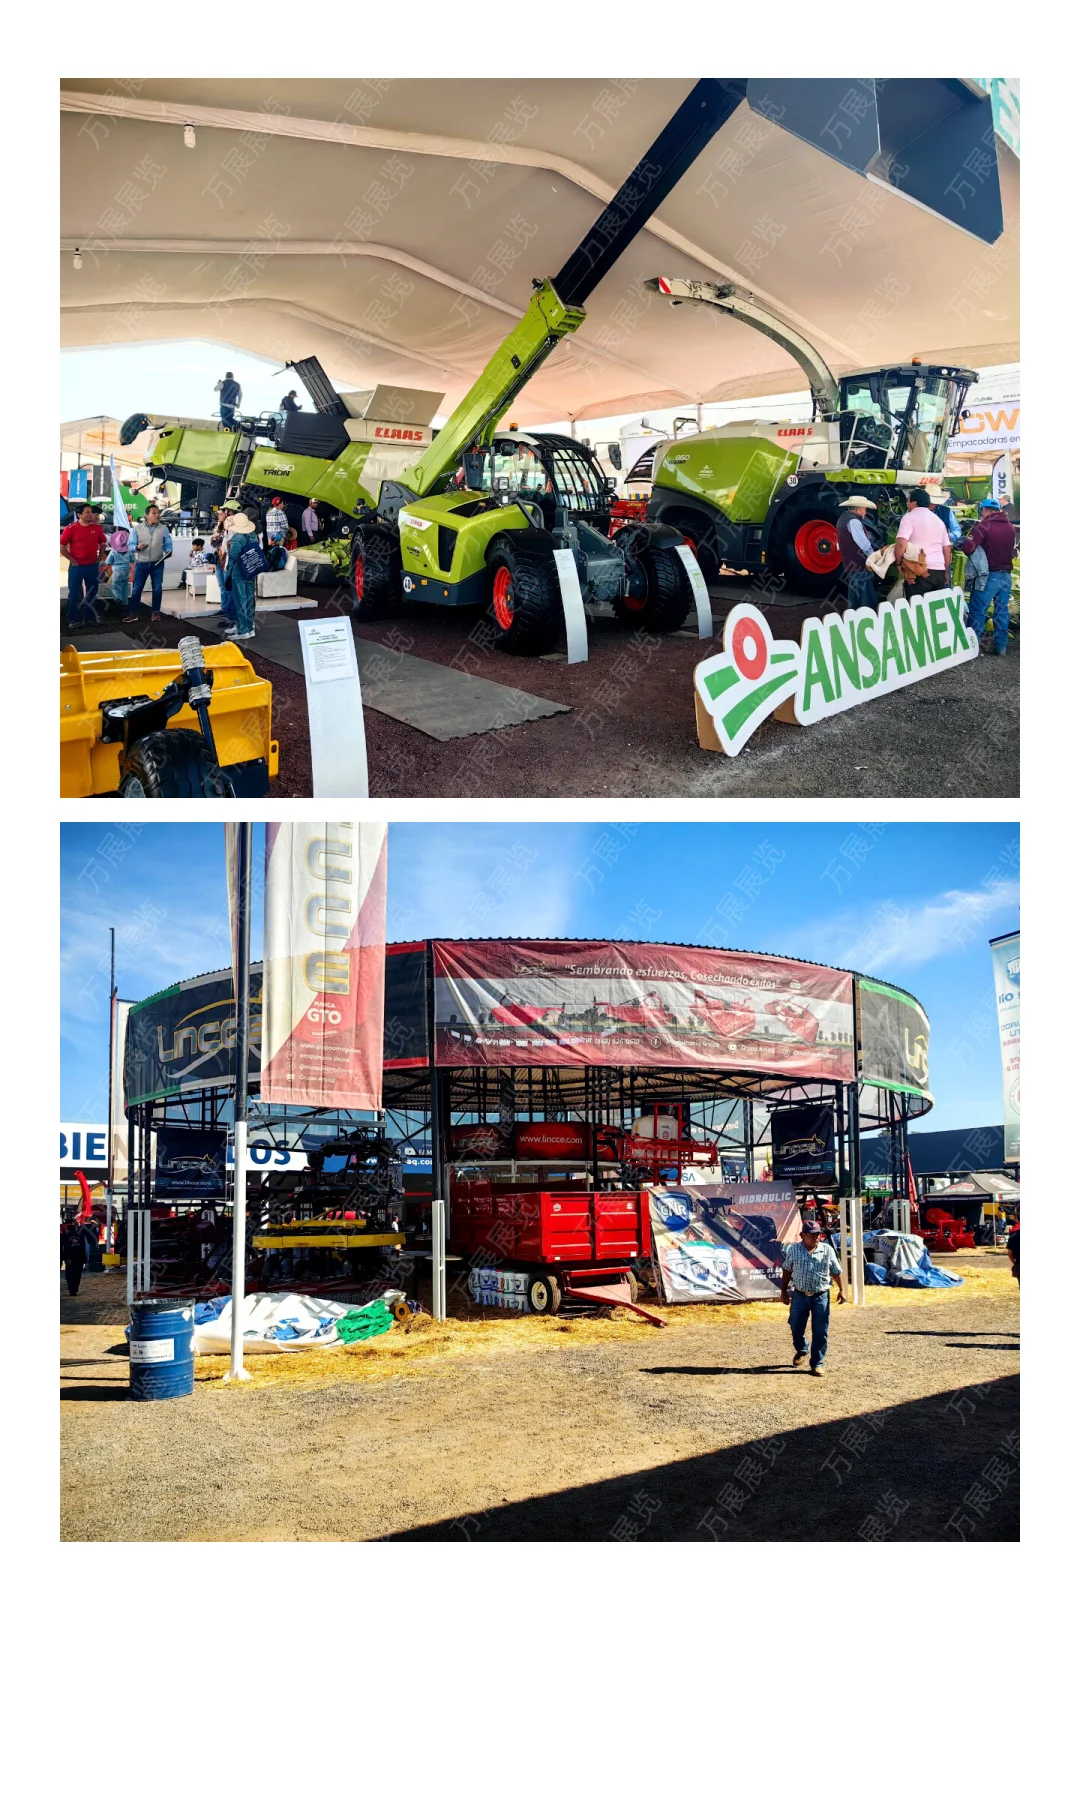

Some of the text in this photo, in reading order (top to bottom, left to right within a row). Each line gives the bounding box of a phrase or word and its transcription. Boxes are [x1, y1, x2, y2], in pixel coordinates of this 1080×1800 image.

[375, 427, 423, 441] CLAAS
[777, 428, 813, 437] CLAAS
[948, 438, 1007, 448] Empacadoras
[789, 477, 797, 485] 30
[803, 594, 970, 711] ANSAMEX
[690, 970, 748, 985] Cosechando
[307, 1008, 342, 1025] GTO
[520, 1134, 583, 1145] www.lincce.com
[739, 1192, 792, 1204] HIDRAULIC
